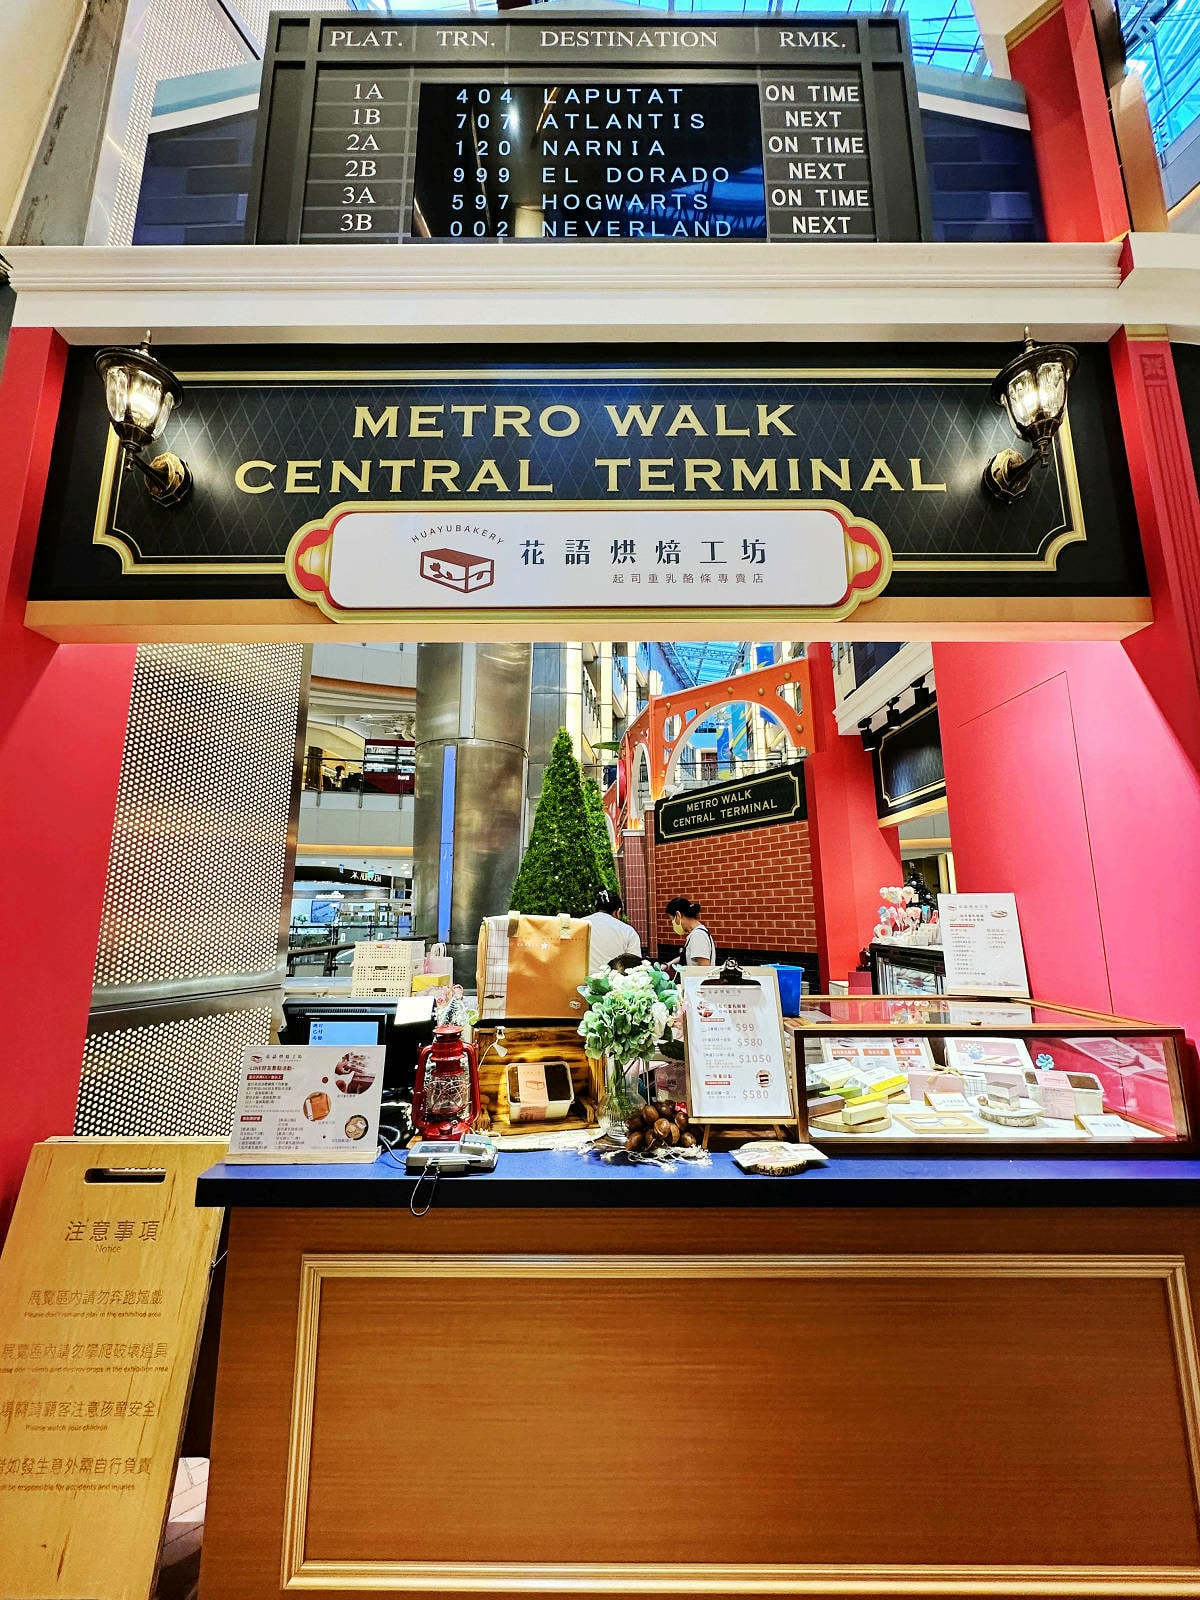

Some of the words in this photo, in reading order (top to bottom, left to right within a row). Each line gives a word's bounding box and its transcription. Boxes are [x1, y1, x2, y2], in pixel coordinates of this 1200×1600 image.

[330, 31, 402, 46] PLAT.
[436, 31, 495, 49] TRN.
[540, 28, 719, 51] DESTINATION
[779, 32, 845, 47] RMK.
[354, 84, 383, 103] 1A
[457, 89, 512, 103] 404
[544, 89, 684, 104] LAPUTAT
[766, 85, 794, 101] ON
[808, 86, 859, 101] TIME
[353, 109, 380, 124] 1B
[457, 113, 515, 129] 707
[542, 113, 706, 129] ATLANTIS
[786, 111, 841, 127] NEXT
[347, 134, 379, 150] 2A
[456, 137, 514, 155] 120
[544, 141, 664, 155] NARNIA
[769, 136, 798, 152] ON
[812, 137, 864, 153] TIME
[345, 161, 376, 176] 2B
[454, 168, 509, 182] 999
[543, 168, 577, 182] EL
[607, 168, 728, 182] DORADO
[789, 163, 846, 179] NEXT
[343, 187, 376, 203] 3A
[452, 195, 508, 209] 597
[539, 194, 707, 210] HOGWARTS
[772, 188, 807, 206] ON
[816, 190, 868, 206] TIME
[341, 214, 372, 231] 3B
[451, 221, 507, 240] 002
[539, 218, 730, 238] NEVERLAND
[793, 217, 850, 233] NEXT
[353, 405, 580, 438] METRO
[606, 405, 796, 436] WALK
[235, 459, 552, 494] CENTRAL
[595, 458, 947, 492] TERMINAL
[411, 525, 504, 546] HUAYUBAKERY
[520, 539, 766, 565] 花語烘焙工坊
[613, 573, 763, 584] 起司重乳酪條專賣店
[687, 798, 718, 812] METRO
[721, 790, 752, 804] WALK
[673, 813, 715, 828] CENTRAL
[720, 799, 777, 819] TERMINAL
[738, 1038, 762, 1047] $580
[739, 1054, 771, 1063] $1050
[743, 1090, 768, 1099] $580
[65, 1220, 160, 1242] 注意事項
[96, 1244, 122, 1254] Notice
